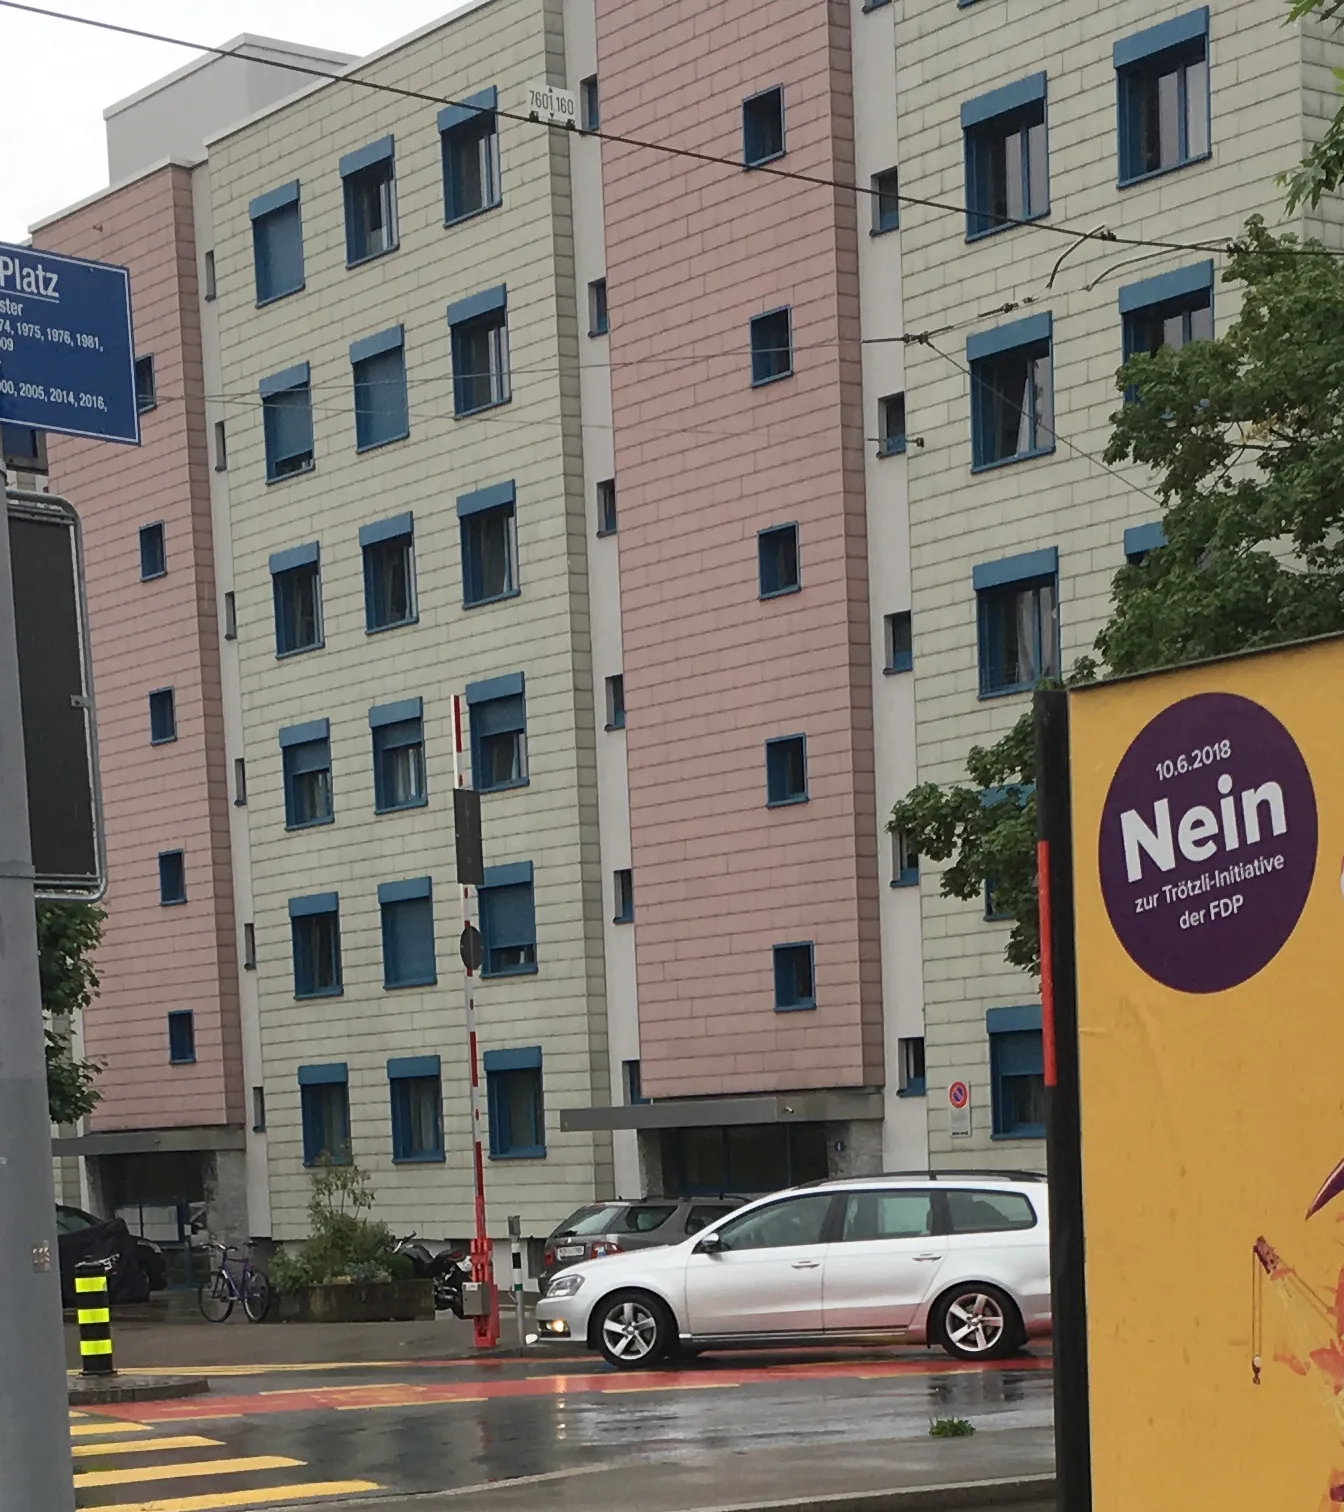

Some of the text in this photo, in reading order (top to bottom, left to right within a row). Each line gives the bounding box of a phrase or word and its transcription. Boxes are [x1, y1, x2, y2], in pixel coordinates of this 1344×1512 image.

[16, 322, 45, 342] 1975,
[46, 328, 74, 347] 1976,
[76, 333, 103, 353] 1981,
[19, 382, 48, 403] 2005,
[49, 388, 78, 408] 2014,
[79, 393, 108, 413] 2016,
[1156, 739, 1232, 781] 10.6.2018
[1120, 773, 1288, 883] Nein
[1134, 853, 1285, 913] zur Trötzli-Initiative
[1179, 894, 1244, 930] der FDP
